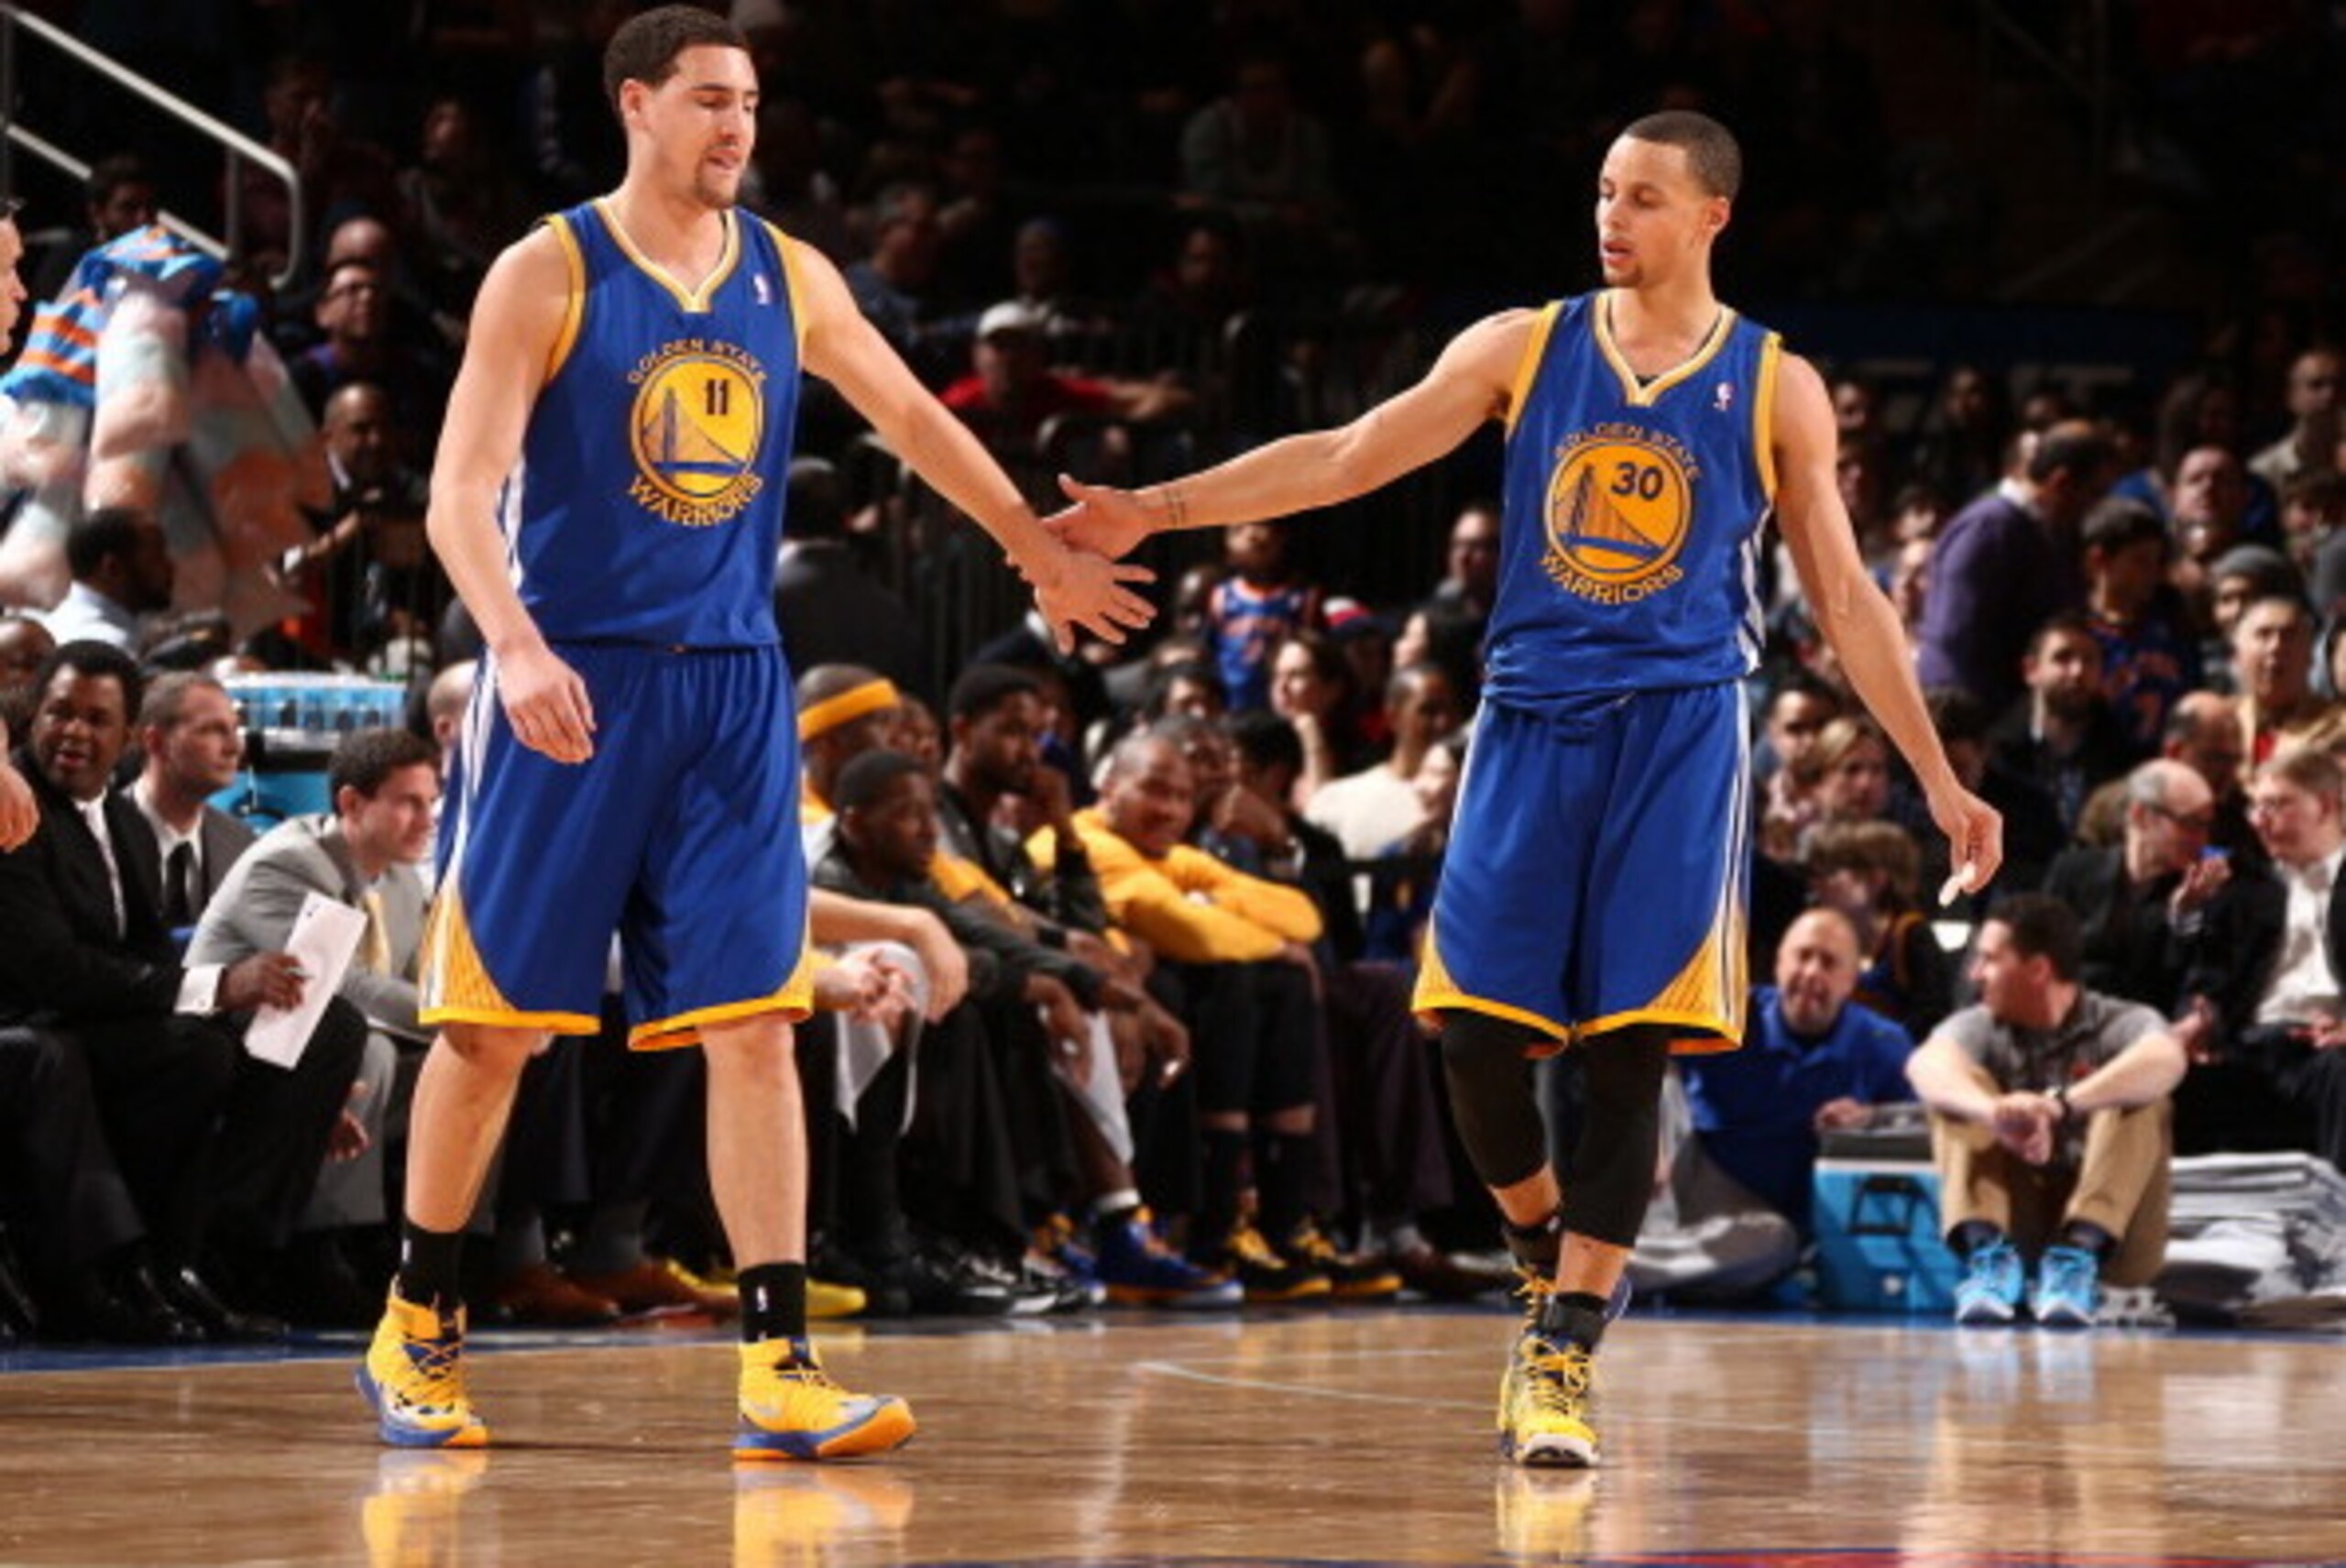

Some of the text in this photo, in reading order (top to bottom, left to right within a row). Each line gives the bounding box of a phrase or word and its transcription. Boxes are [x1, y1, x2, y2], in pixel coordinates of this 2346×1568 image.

[629, 339, 767, 382] GOLDEN STATE
[706, 378, 729, 416] 11
[1553, 422, 1702, 481] GOLDEN STATE
[628, 473, 763, 526] WARRIORS
[1611, 461, 1664, 501] 30
[1540, 545, 1684, 605] WARRIORS
